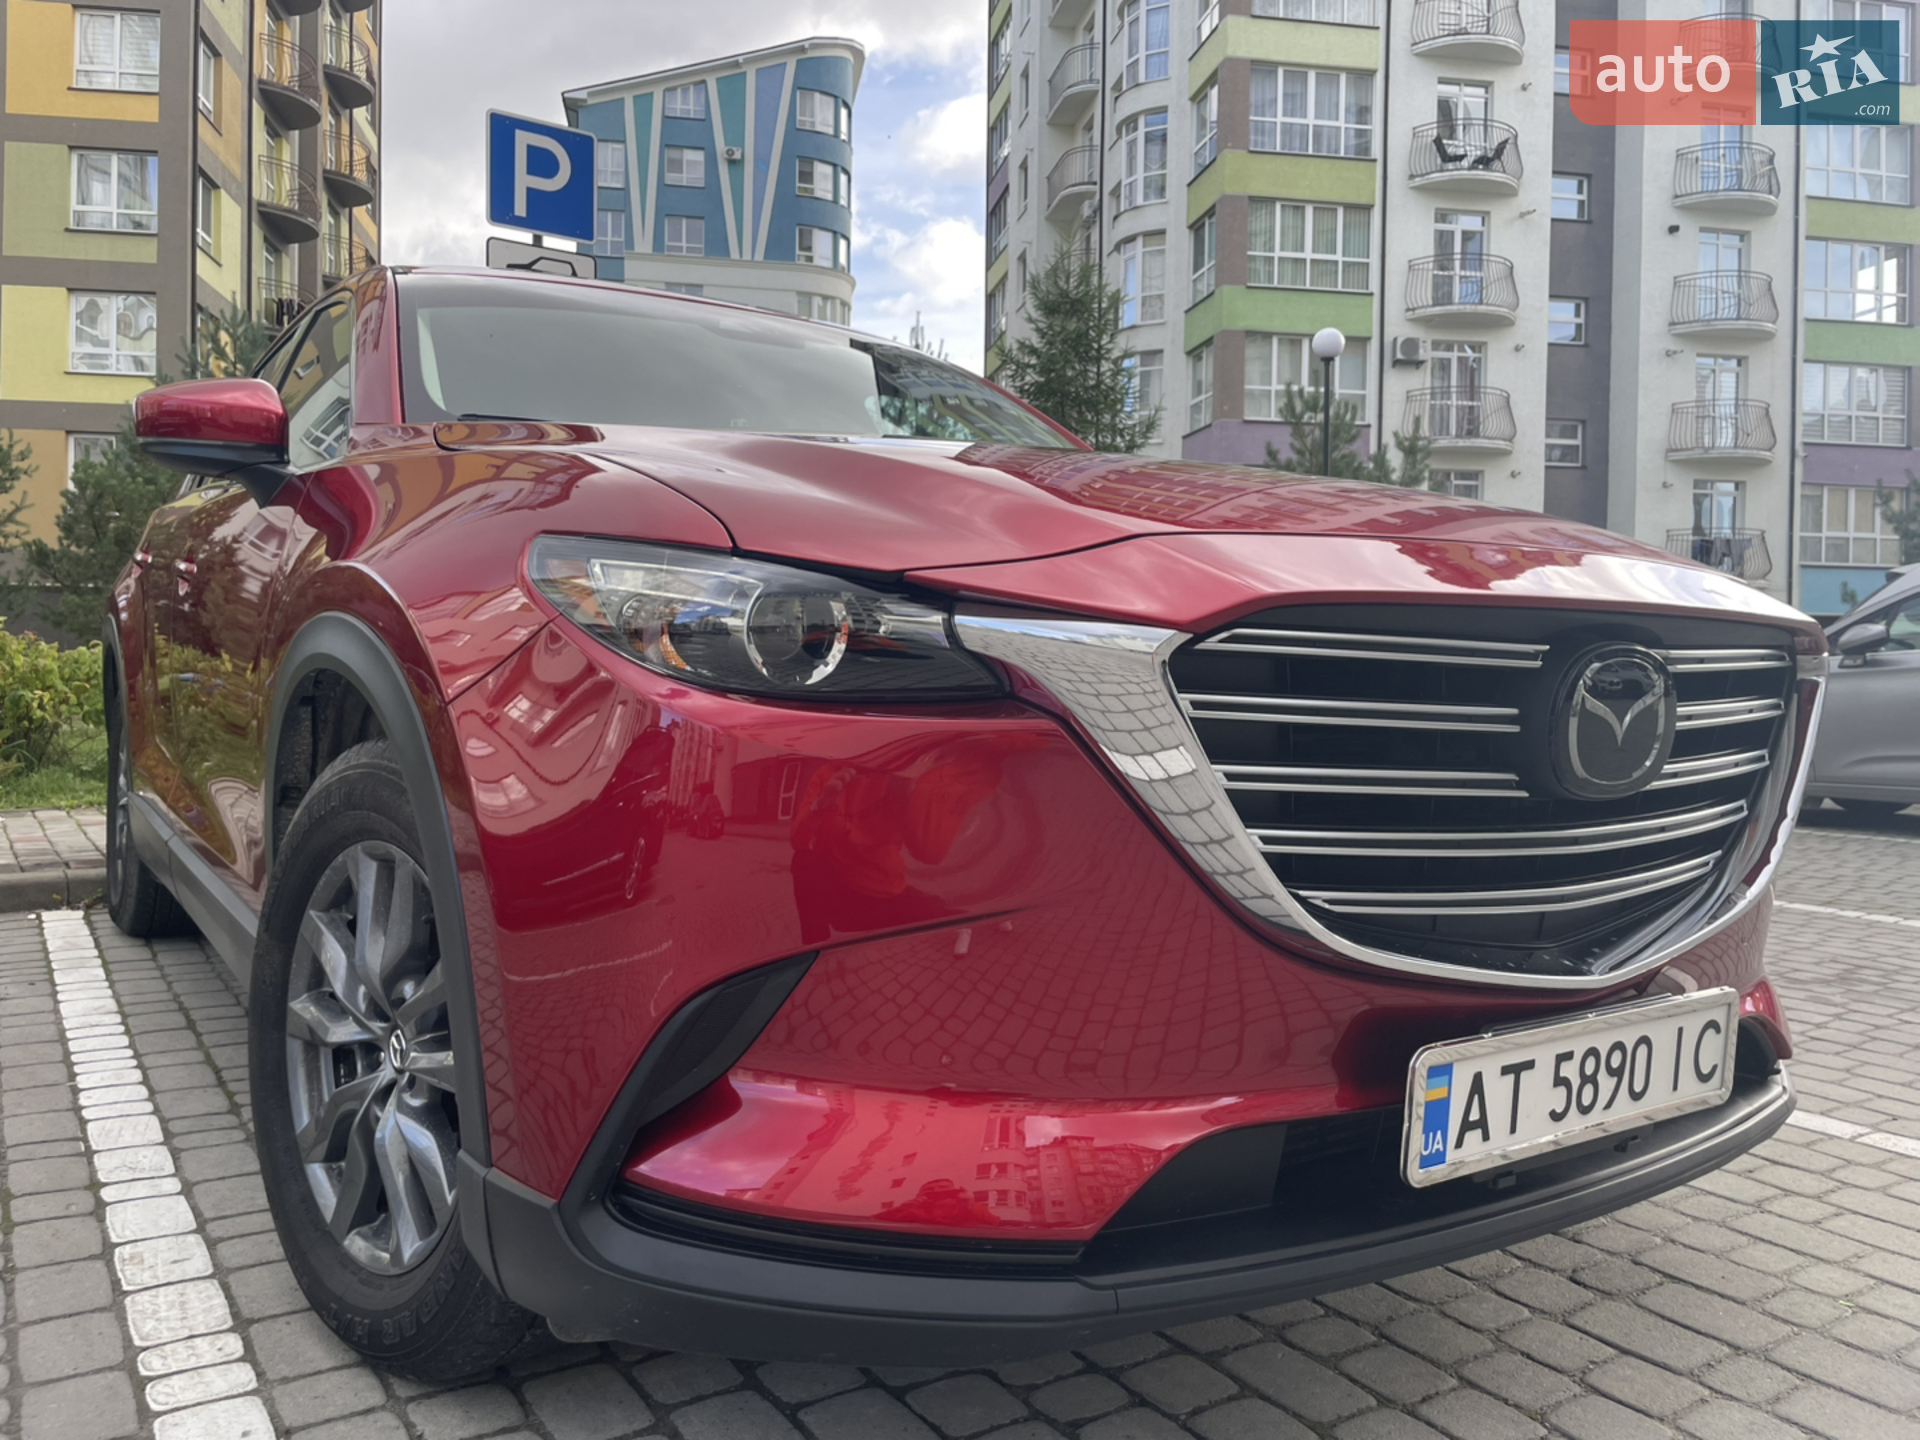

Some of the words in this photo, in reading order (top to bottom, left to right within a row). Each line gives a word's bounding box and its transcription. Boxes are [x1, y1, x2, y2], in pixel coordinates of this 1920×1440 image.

[514, 128, 572, 218] P
[1454, 1058, 1536, 1150] AT
[1549, 1034, 1653, 1122] 5890
[1671, 1019, 1721, 1092] IC
[1421, 1129, 1444, 1156] UA
